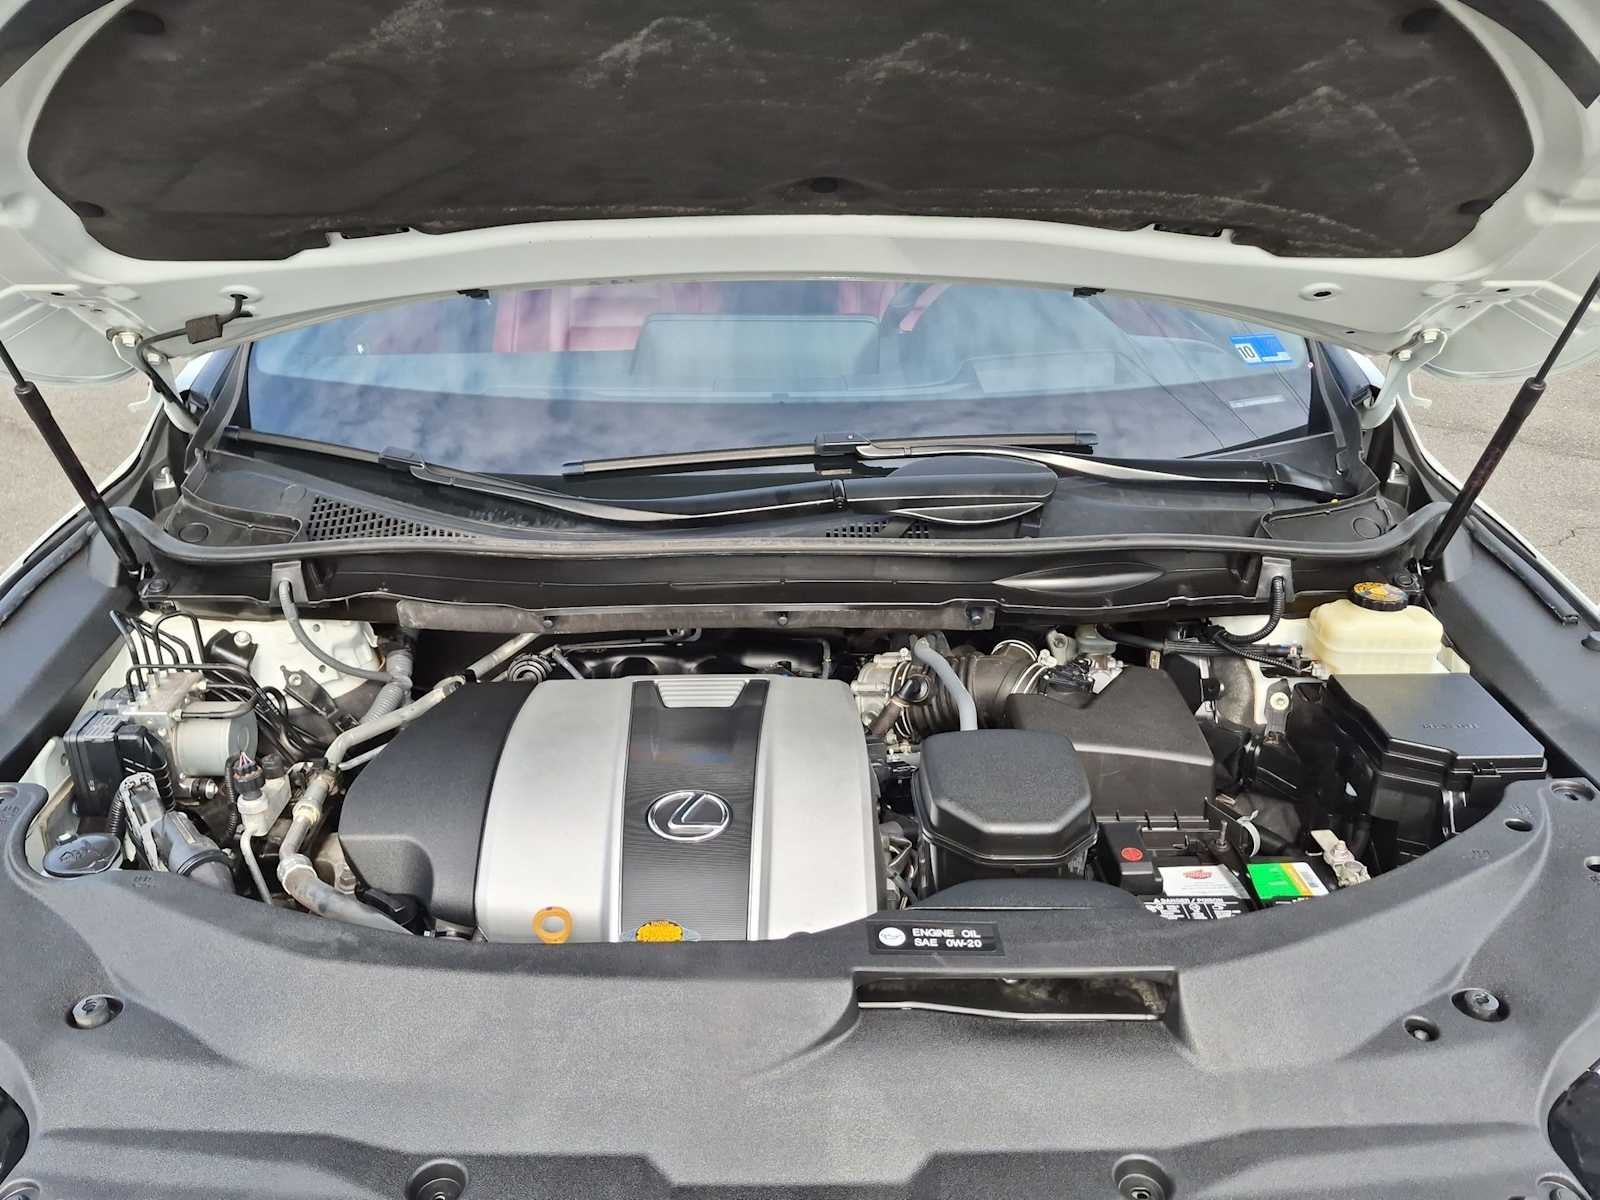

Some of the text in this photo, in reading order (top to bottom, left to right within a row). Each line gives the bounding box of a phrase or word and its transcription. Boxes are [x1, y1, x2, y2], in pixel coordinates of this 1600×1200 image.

[1239, 345, 1255, 359] 10
[912, 928, 981, 938] ENGINE OIL
[914, 938, 982, 948] SAE 0W-20
